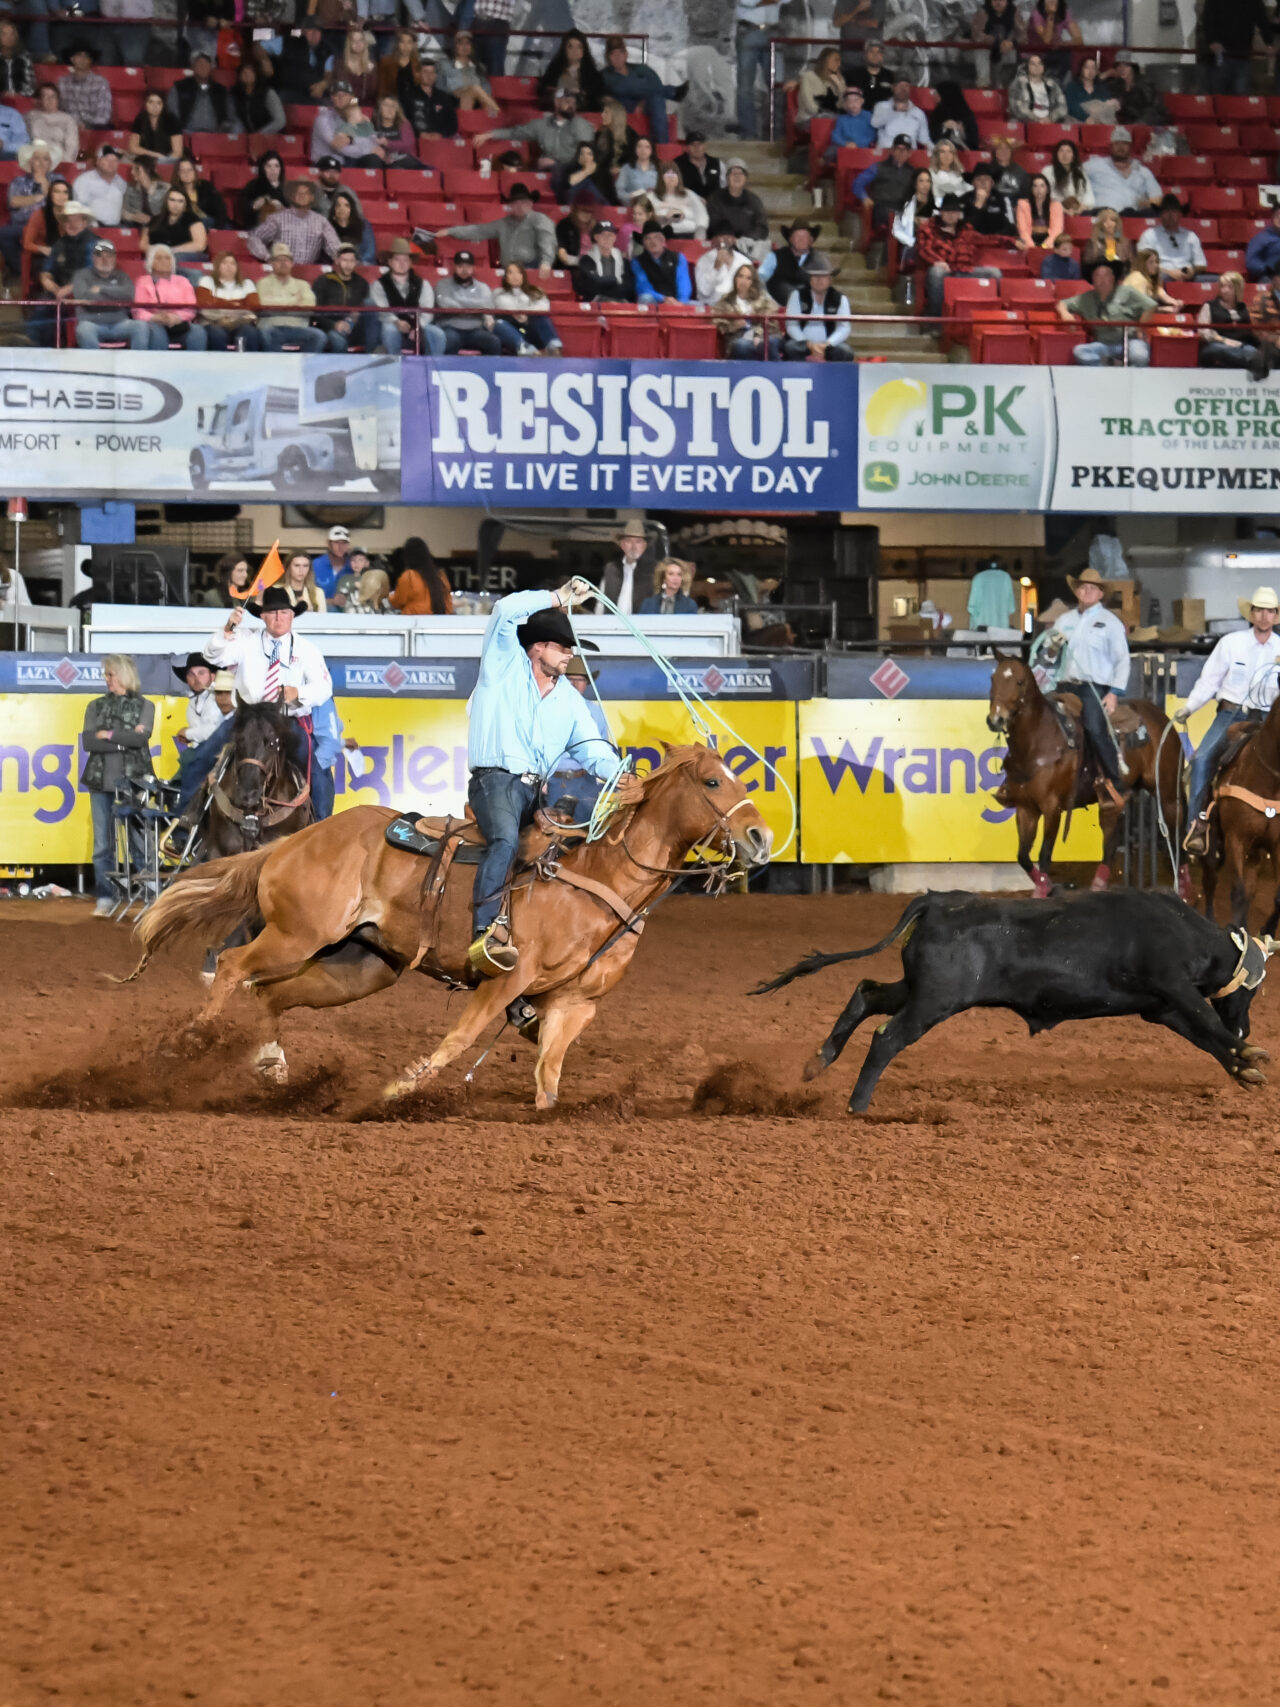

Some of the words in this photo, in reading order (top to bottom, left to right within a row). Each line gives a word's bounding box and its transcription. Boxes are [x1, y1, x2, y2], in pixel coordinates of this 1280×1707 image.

[1189, 387, 1226, 396] PROUD
[1229, 387, 1242, 396] TO
[1246, 388, 1257, 396] BE
[1263, 388, 1280, 397] THE
[431, 370, 829, 459] RESISTOL
[932, 384, 1026, 436] P&K
[1101, 418, 1228, 437] TRACTOR
[96, 434, 162, 452] POWER
[868, 440, 1028, 453] EQUIPMENT
[1162, 439, 1178, 449] OF
[1185, 440, 1208, 450] THE
[1213, 440, 1247, 450] LAZY
[438, 461, 494, 489] WE
[506, 462, 577, 490] LIVE
[590, 464, 619, 491] IT
[631, 464, 742, 492] EVERY
[752, 466, 823, 493] DAY
[908, 470, 961, 486] JOHN
[965, 471, 1029, 486] DEERE
[451, 566, 517, 589] THER
[17, 666, 51, 679] LAZY
[346, 670, 380, 683] LAZY
[409, 671, 455, 684] ARENA
[727, 674, 771, 687] ARENA
[810, 736, 1016, 823] Wrang
